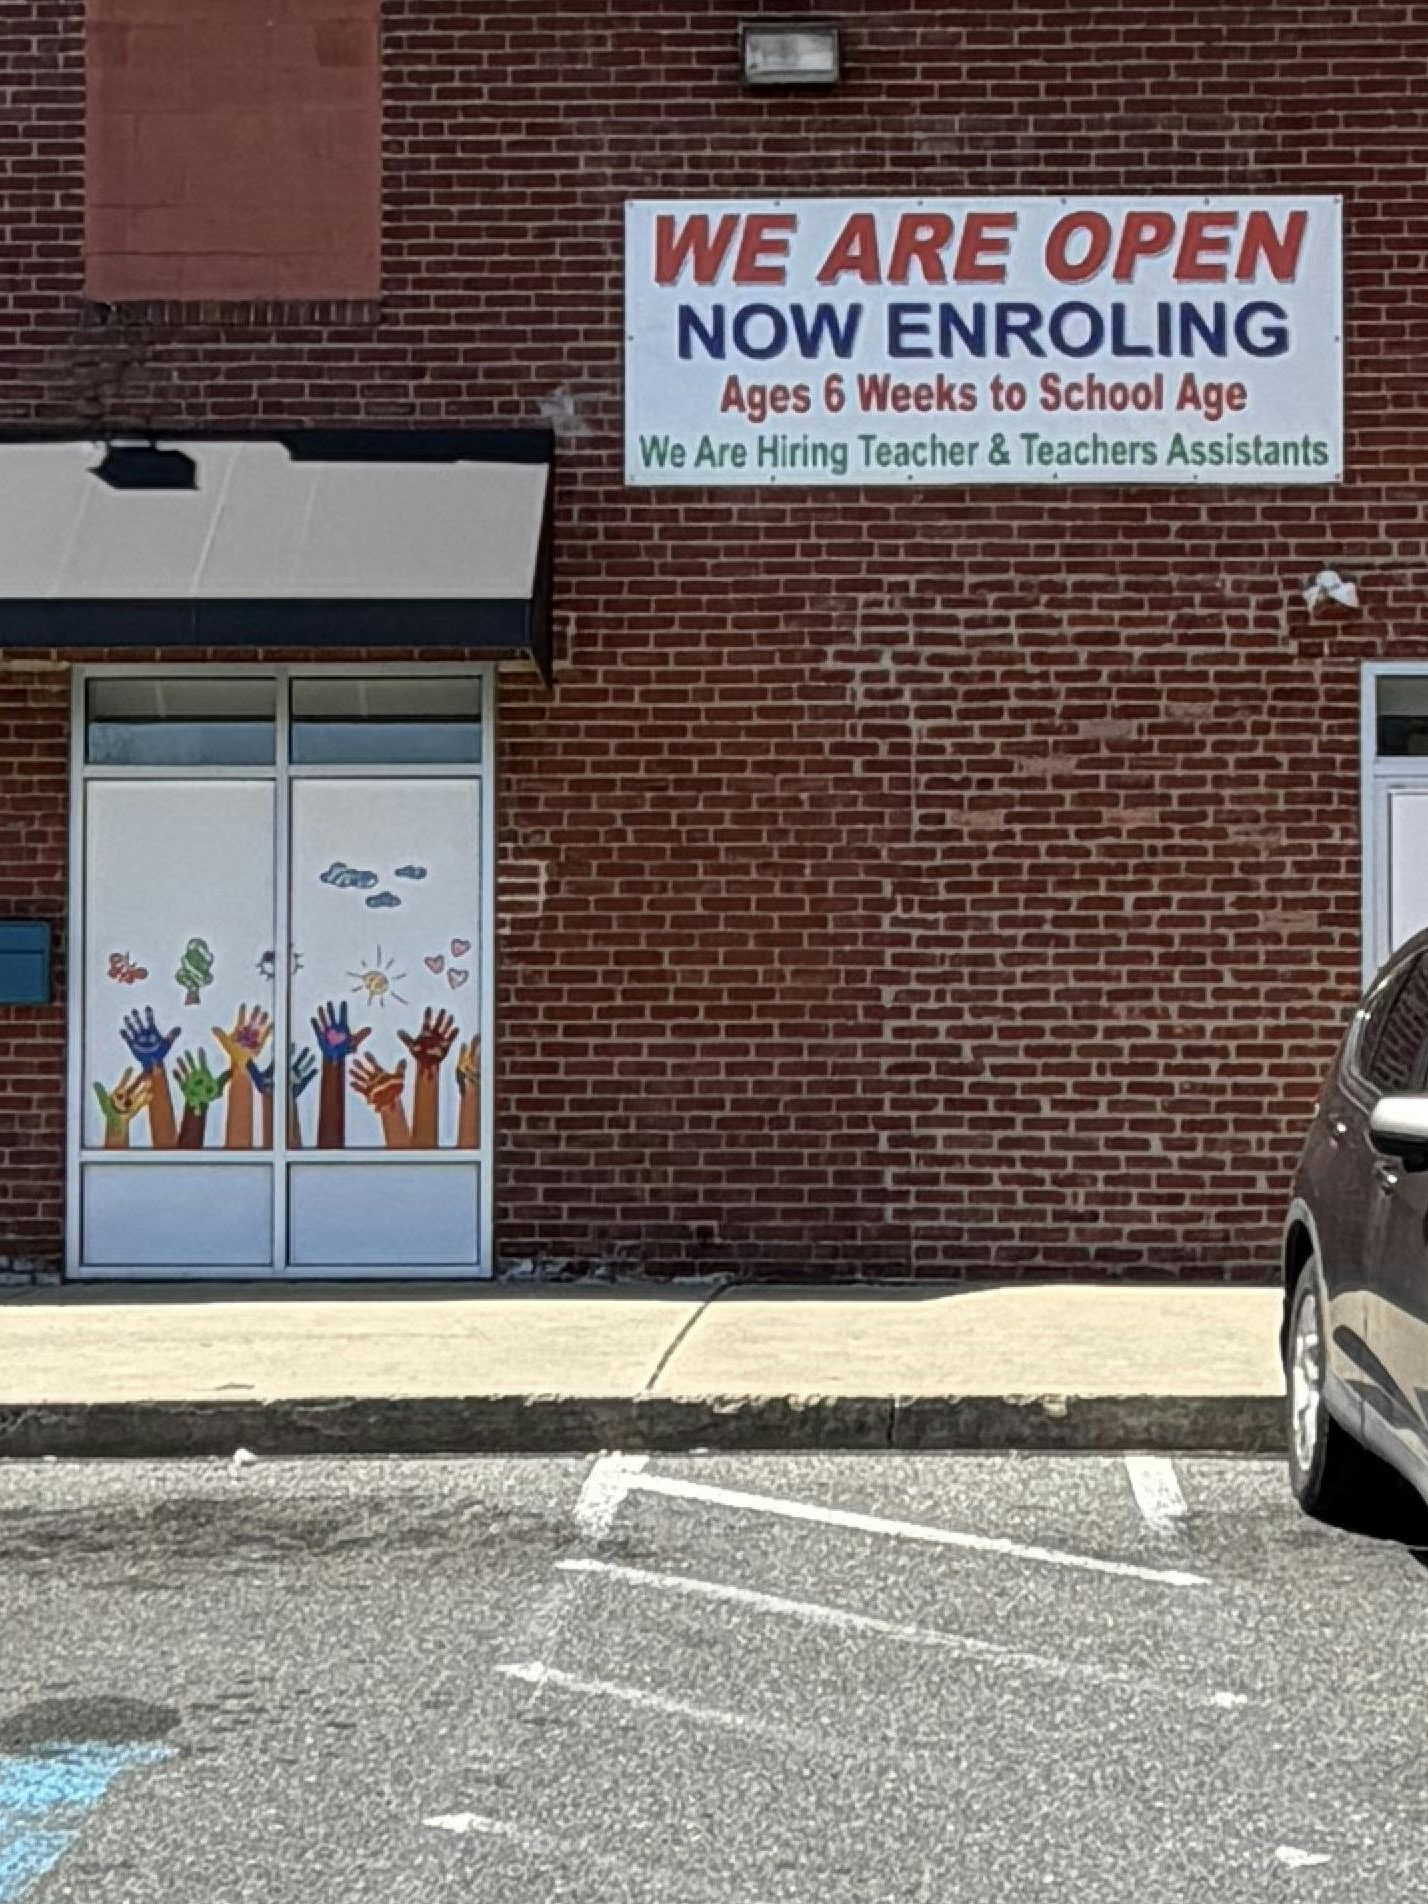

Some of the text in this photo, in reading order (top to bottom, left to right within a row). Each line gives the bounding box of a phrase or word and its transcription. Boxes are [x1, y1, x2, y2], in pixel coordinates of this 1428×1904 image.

[654, 209, 1308, 287] WE ARE OPEN
[678, 300, 1291, 360] NOW ENROLING
[720, 372, 1248, 424] Ages 6 Weeks to School Age
[639, 432, 1329, 475] We Are Hiring Teacher & Teachers Assistants
